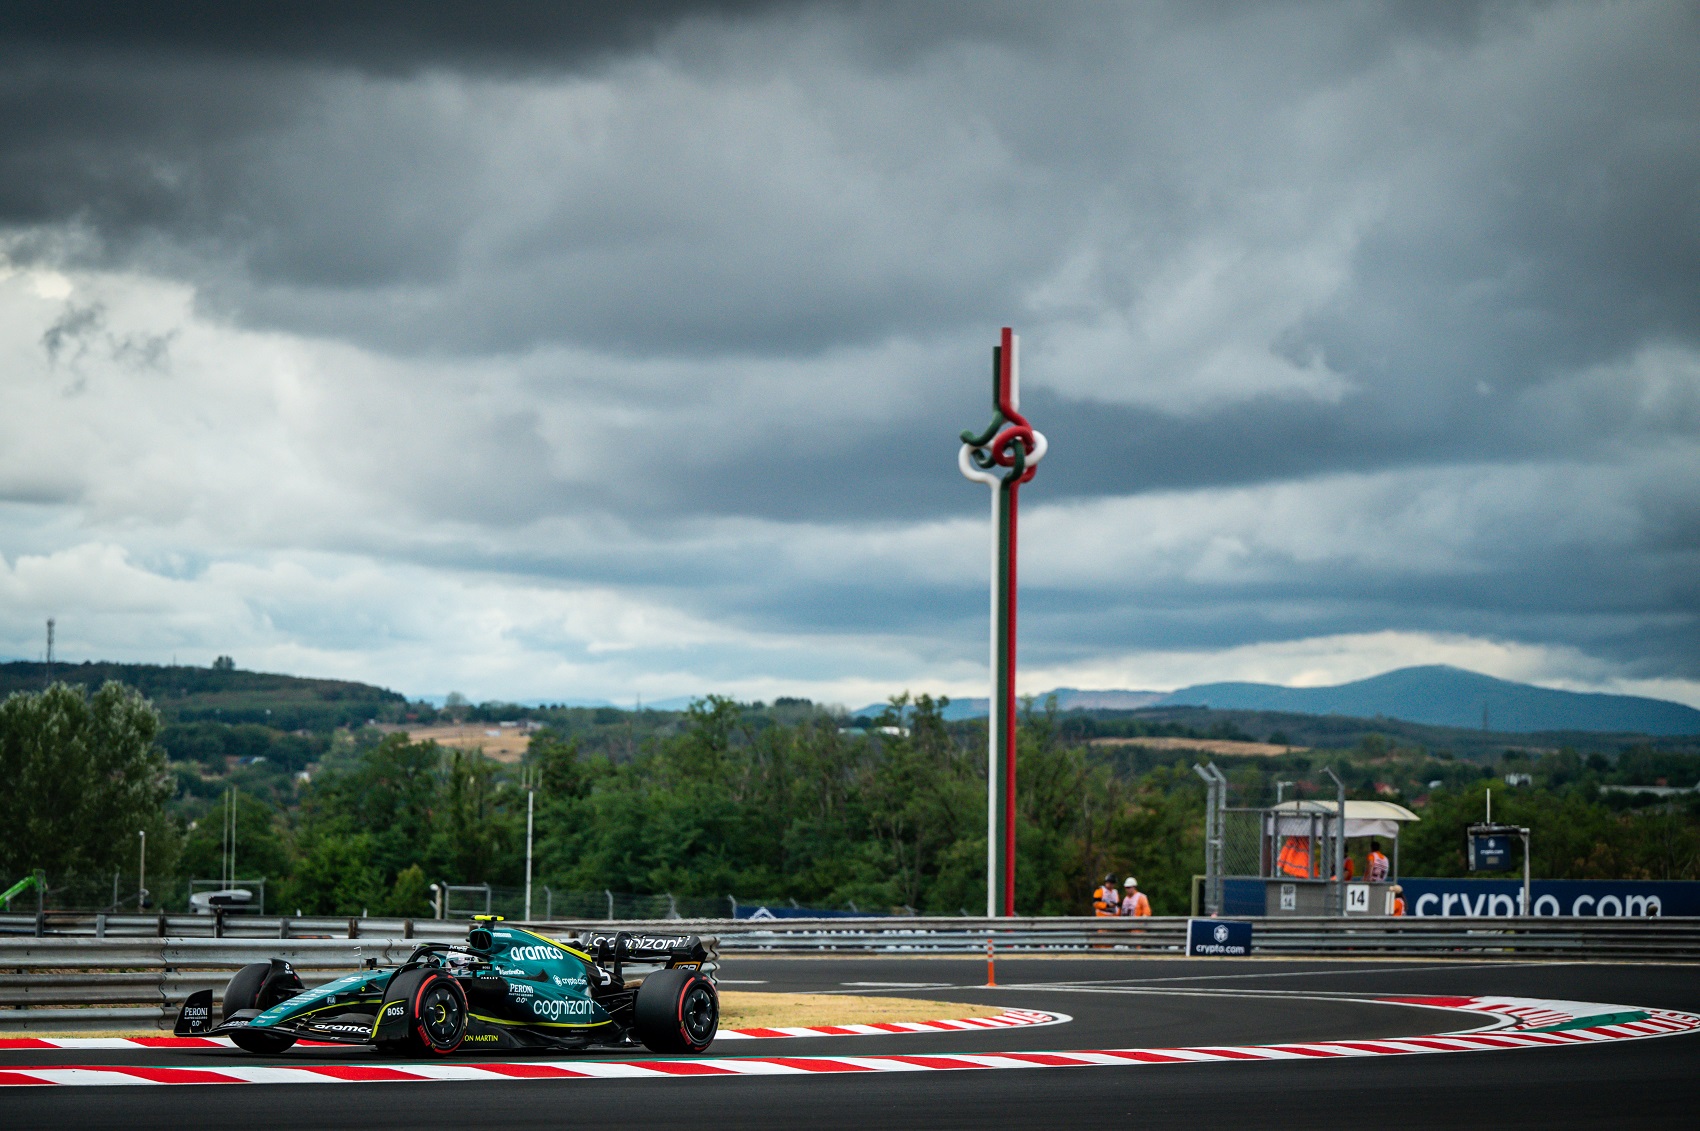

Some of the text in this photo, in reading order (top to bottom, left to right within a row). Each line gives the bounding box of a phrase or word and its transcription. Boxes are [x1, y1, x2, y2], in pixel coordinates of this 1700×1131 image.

[1350, 890, 1365, 906] 14
[510, 946, 563, 961] aramco
[1195, 944, 1246, 954] crypto.com
[509, 983, 534, 994] PERONI
[184, 1007, 208, 1016] PERONI
[387, 1007, 404, 1016] BOSS
[533, 996, 595, 1021] cognizant
[475, 1034, 499, 1042] MARTIN
